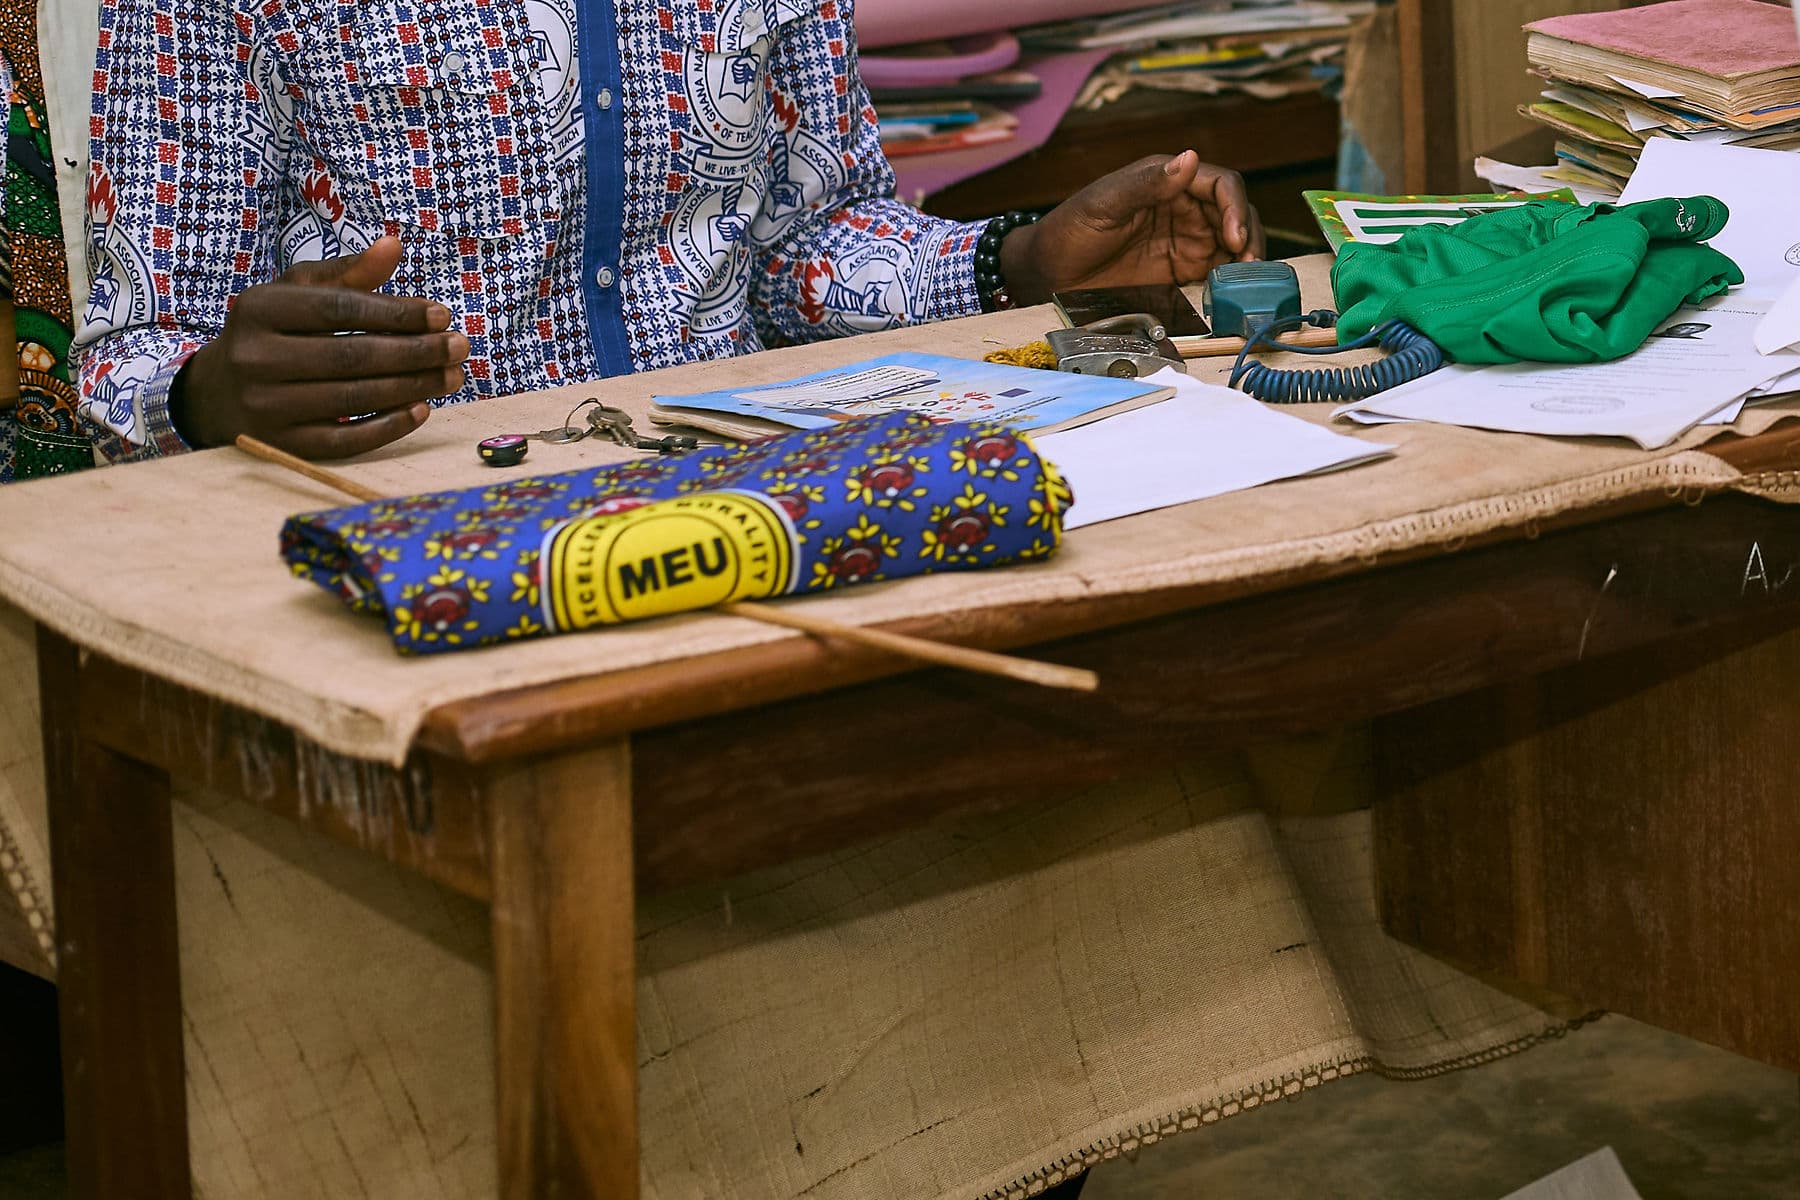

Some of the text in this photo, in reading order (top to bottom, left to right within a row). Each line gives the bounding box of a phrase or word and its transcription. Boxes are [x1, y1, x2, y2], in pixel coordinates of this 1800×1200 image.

[549, 88, 570, 121] CHERS
[694, 76, 717, 122] GHANA
[557, 126, 579, 150] TEACH
[720, 127, 733, 139] OF
[704, 160, 717, 174] WE
[719, 161, 737, 176] LIVE
[681, 239, 711, 278] GHANA
[114, 241, 146, 322] ASSOCIATION
[723, 309, 734, 321] TO
[675, 500, 769, 583] MORALITY
[618, 536, 729, 601] MEU
